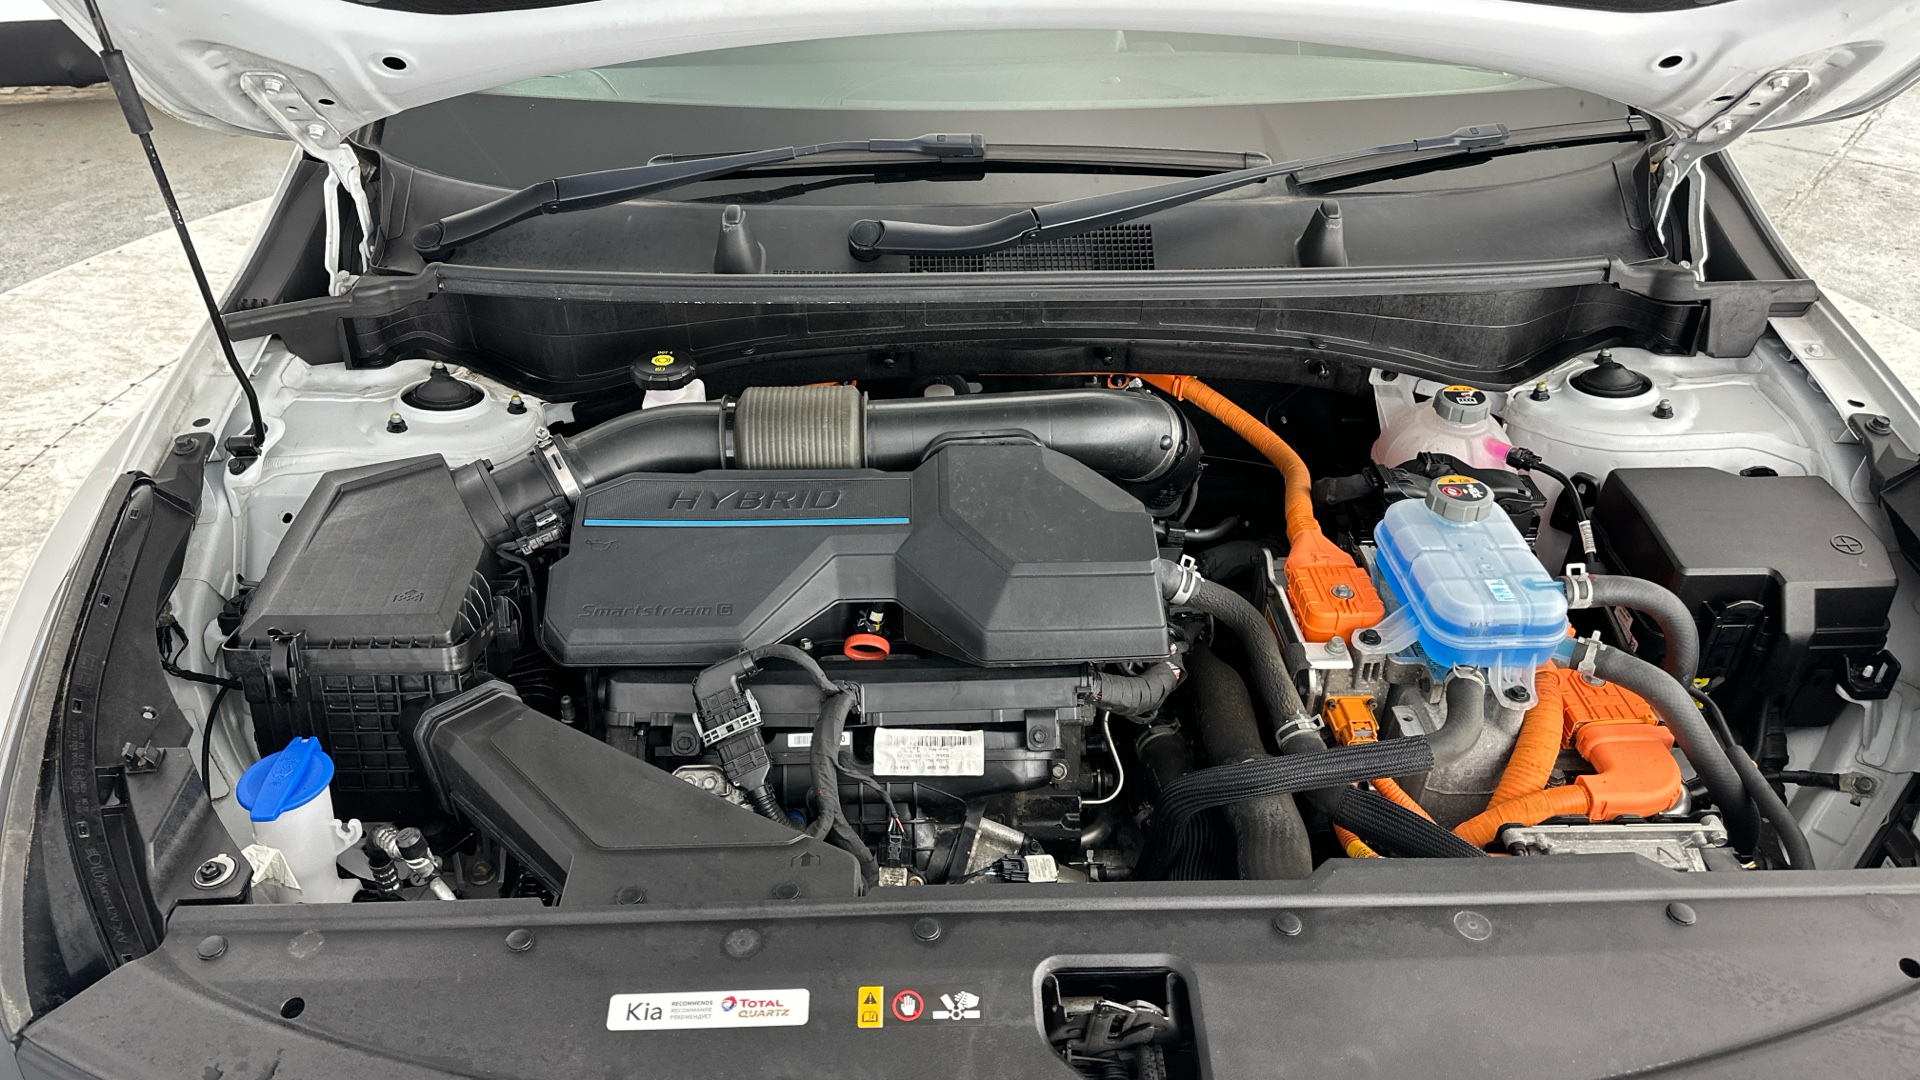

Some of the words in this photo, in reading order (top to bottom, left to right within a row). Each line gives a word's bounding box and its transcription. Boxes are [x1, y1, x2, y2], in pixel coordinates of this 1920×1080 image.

[667, 489, 842, 511] HYBRID
[577, 603, 711, 618] Smartstream
[716, 603, 733, 616] G
[739, 999, 784, 1008] TOTAL
[626, 1002, 663, 1021] Kia
[738, 1008, 790, 1018] QUARTZ
